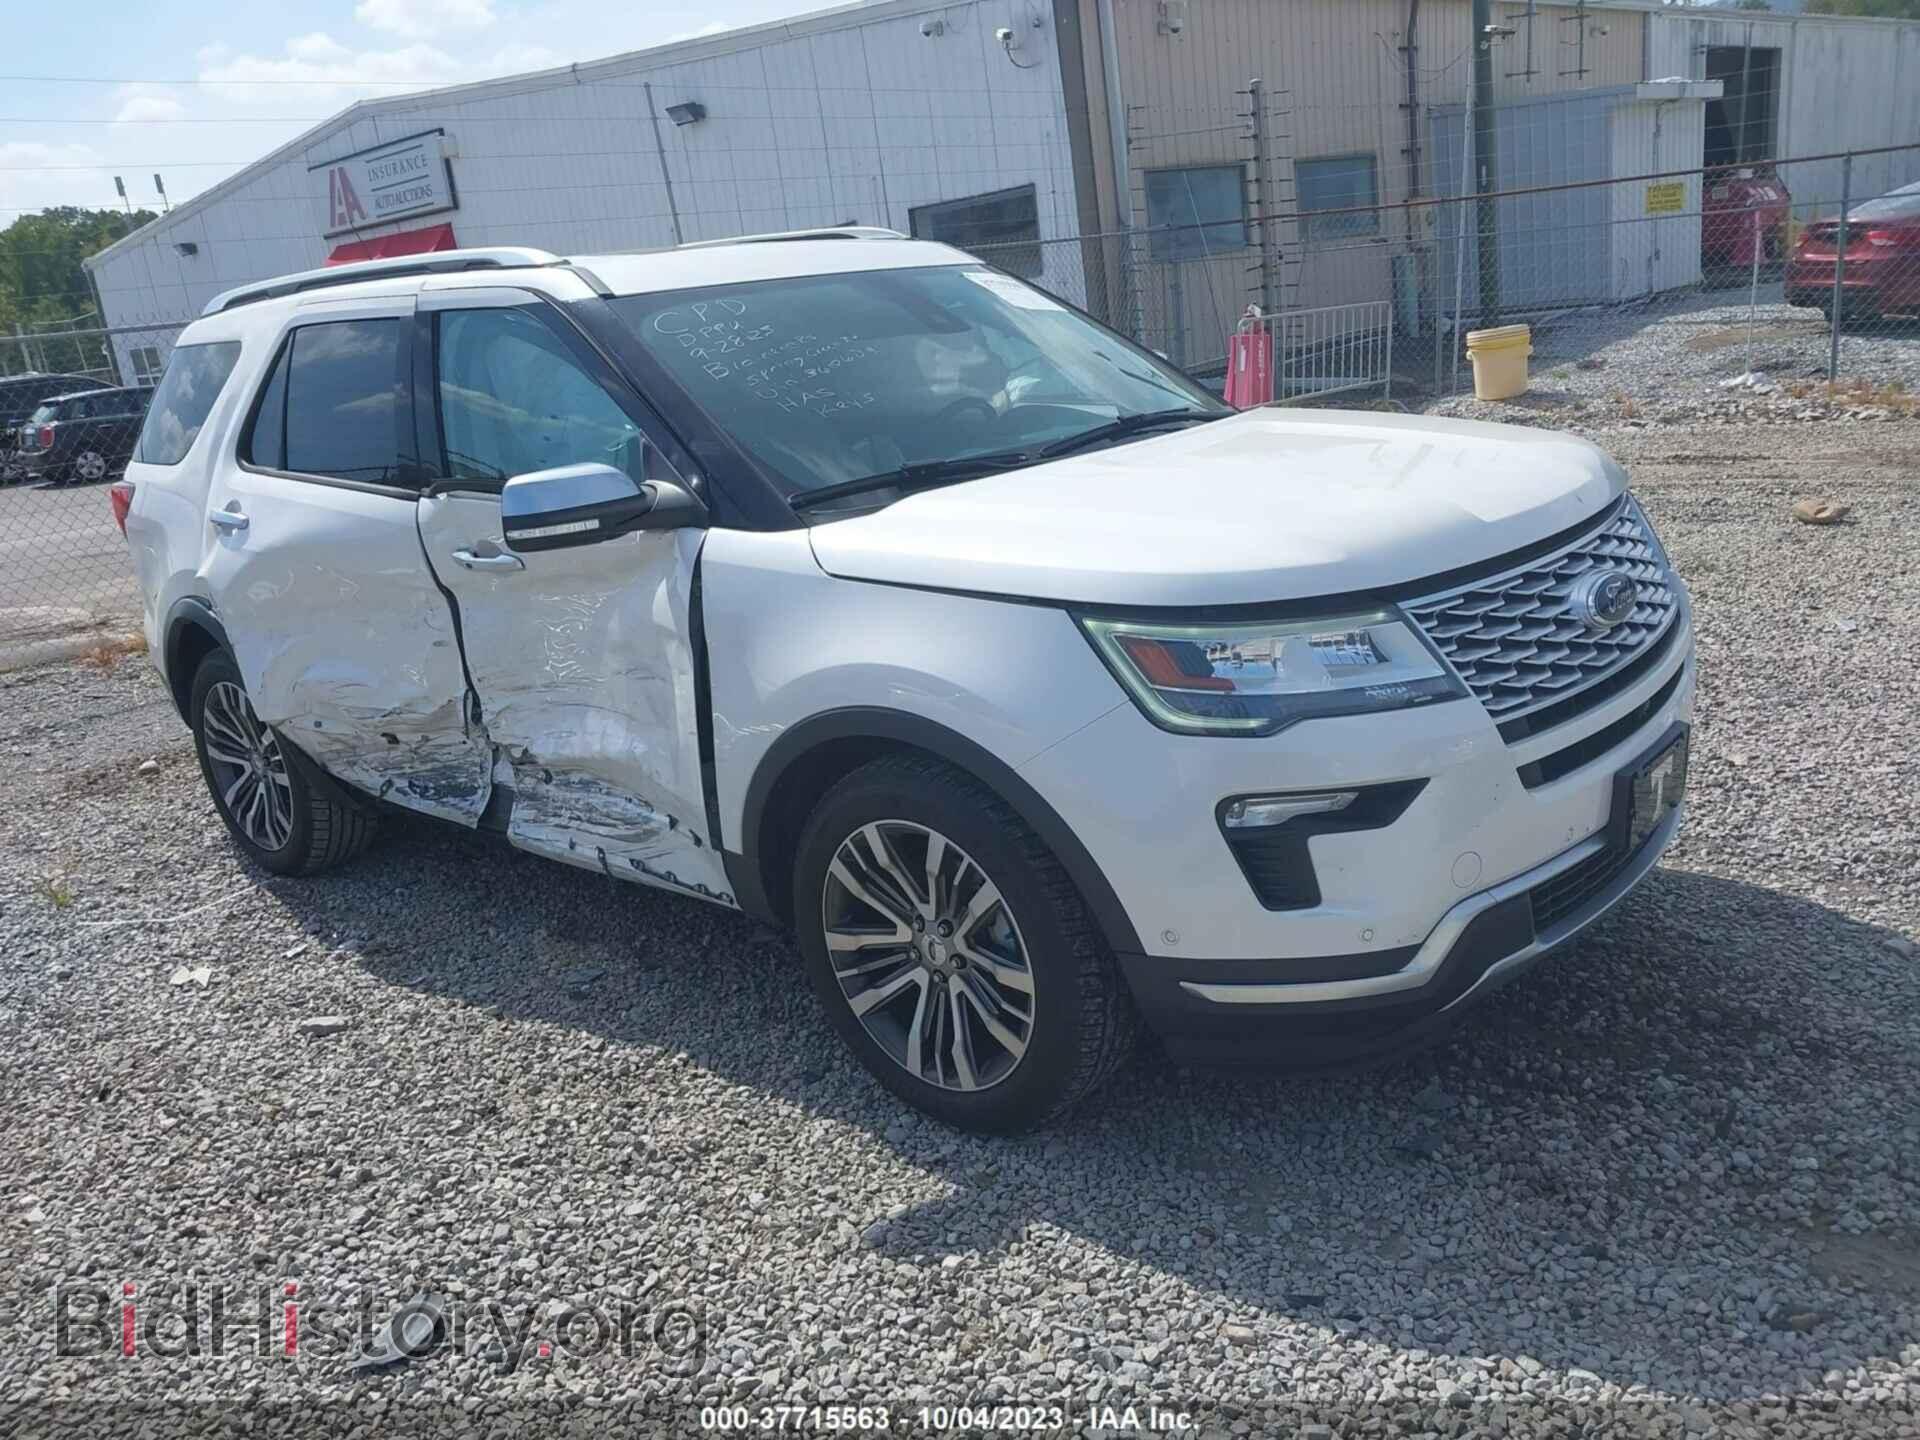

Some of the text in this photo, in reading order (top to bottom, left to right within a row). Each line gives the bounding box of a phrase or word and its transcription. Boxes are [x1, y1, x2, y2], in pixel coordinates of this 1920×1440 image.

[367, 153, 429, 182] INSURANCE
[653, 299, 747, 334] CPD
[777, 387, 836, 413] HAS
[1605, 580, 1634, 614] Ford
